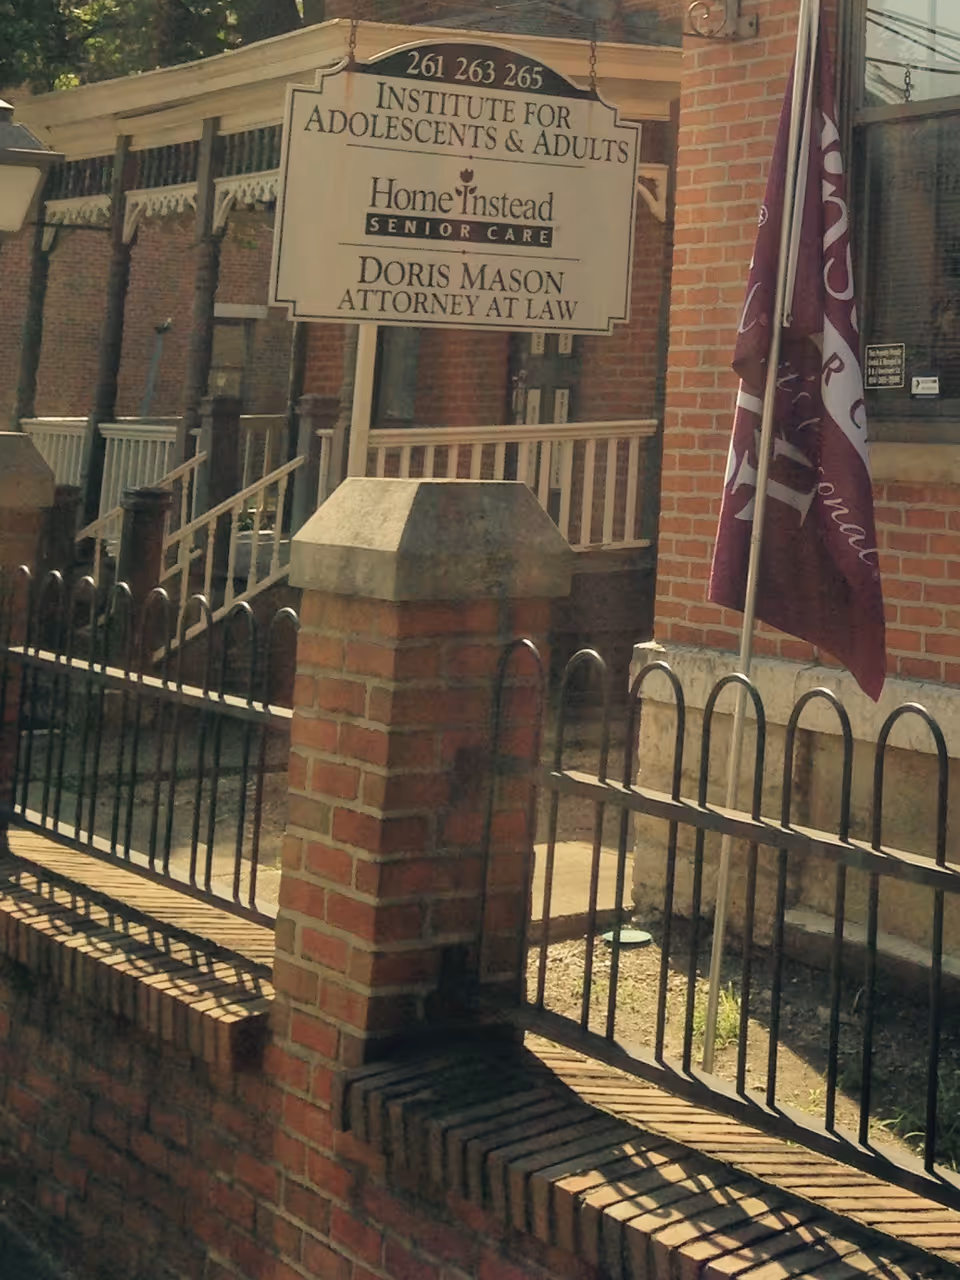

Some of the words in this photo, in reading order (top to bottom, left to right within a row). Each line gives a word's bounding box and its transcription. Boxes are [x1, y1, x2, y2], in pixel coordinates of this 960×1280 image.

[406, 51, 445, 79] 261
[454, 57, 496, 84] 263
[503, 63, 544, 89] 265
[376, 81, 516, 124] INSTITUTE
[523, 102, 572, 130] FOR
[303, 104, 498, 151] ADOLESCENTS
[504, 128, 525, 154] &
[532, 129, 630, 164] ADULTS
[368, 176, 454, 214] Home
[460, 183, 554, 222] Instead
[369, 217, 471, 239] SENIOR
[486, 225, 549, 244] CARE
[357, 255, 451, 289] DORIS
[460, 262, 566, 295] MASON
[336, 287, 481, 317] ATTORNEY
[485, 296, 520, 319] AT
[525, 297, 580, 321] LAW
